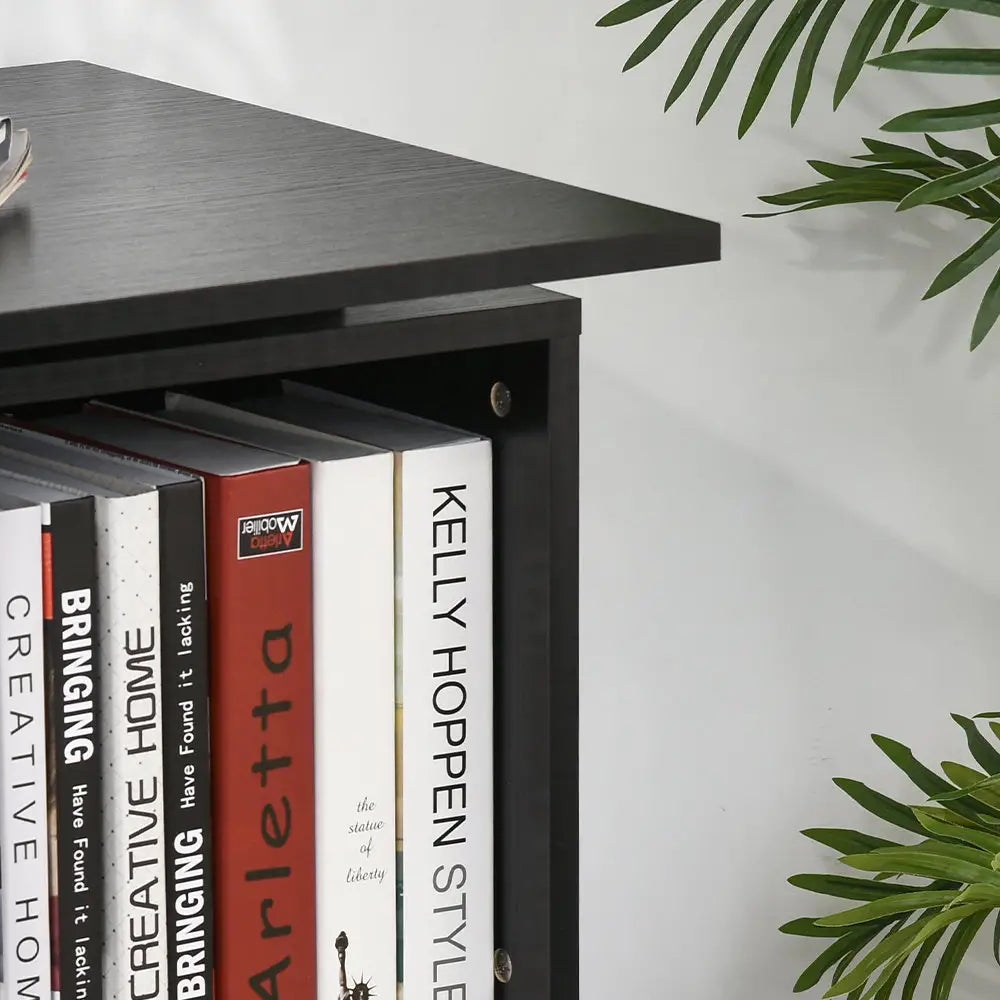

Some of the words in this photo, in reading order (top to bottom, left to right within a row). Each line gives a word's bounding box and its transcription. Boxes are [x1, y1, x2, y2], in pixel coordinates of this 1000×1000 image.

[432, 483, 468, 629] KELLY
[175, 581, 195, 657] lacking
[61, 588, 95, 765] BRINGING
[125, 625, 158, 756] HOME
[177, 666, 194, 689] it
[6, 594, 38, 864] CREATIVE
[178, 700, 195, 755] Found
[432, 645, 468, 849] HOPPEN
[71, 784, 88, 829] Have
[179, 763, 196, 810] Have
[356, 795, 377, 813] the
[347, 819, 387, 835] statue
[359, 836, 373, 859] of
[73, 836, 90, 893] Found
[346, 866, 386, 885] liberty
[73, 904, 89, 925] it
